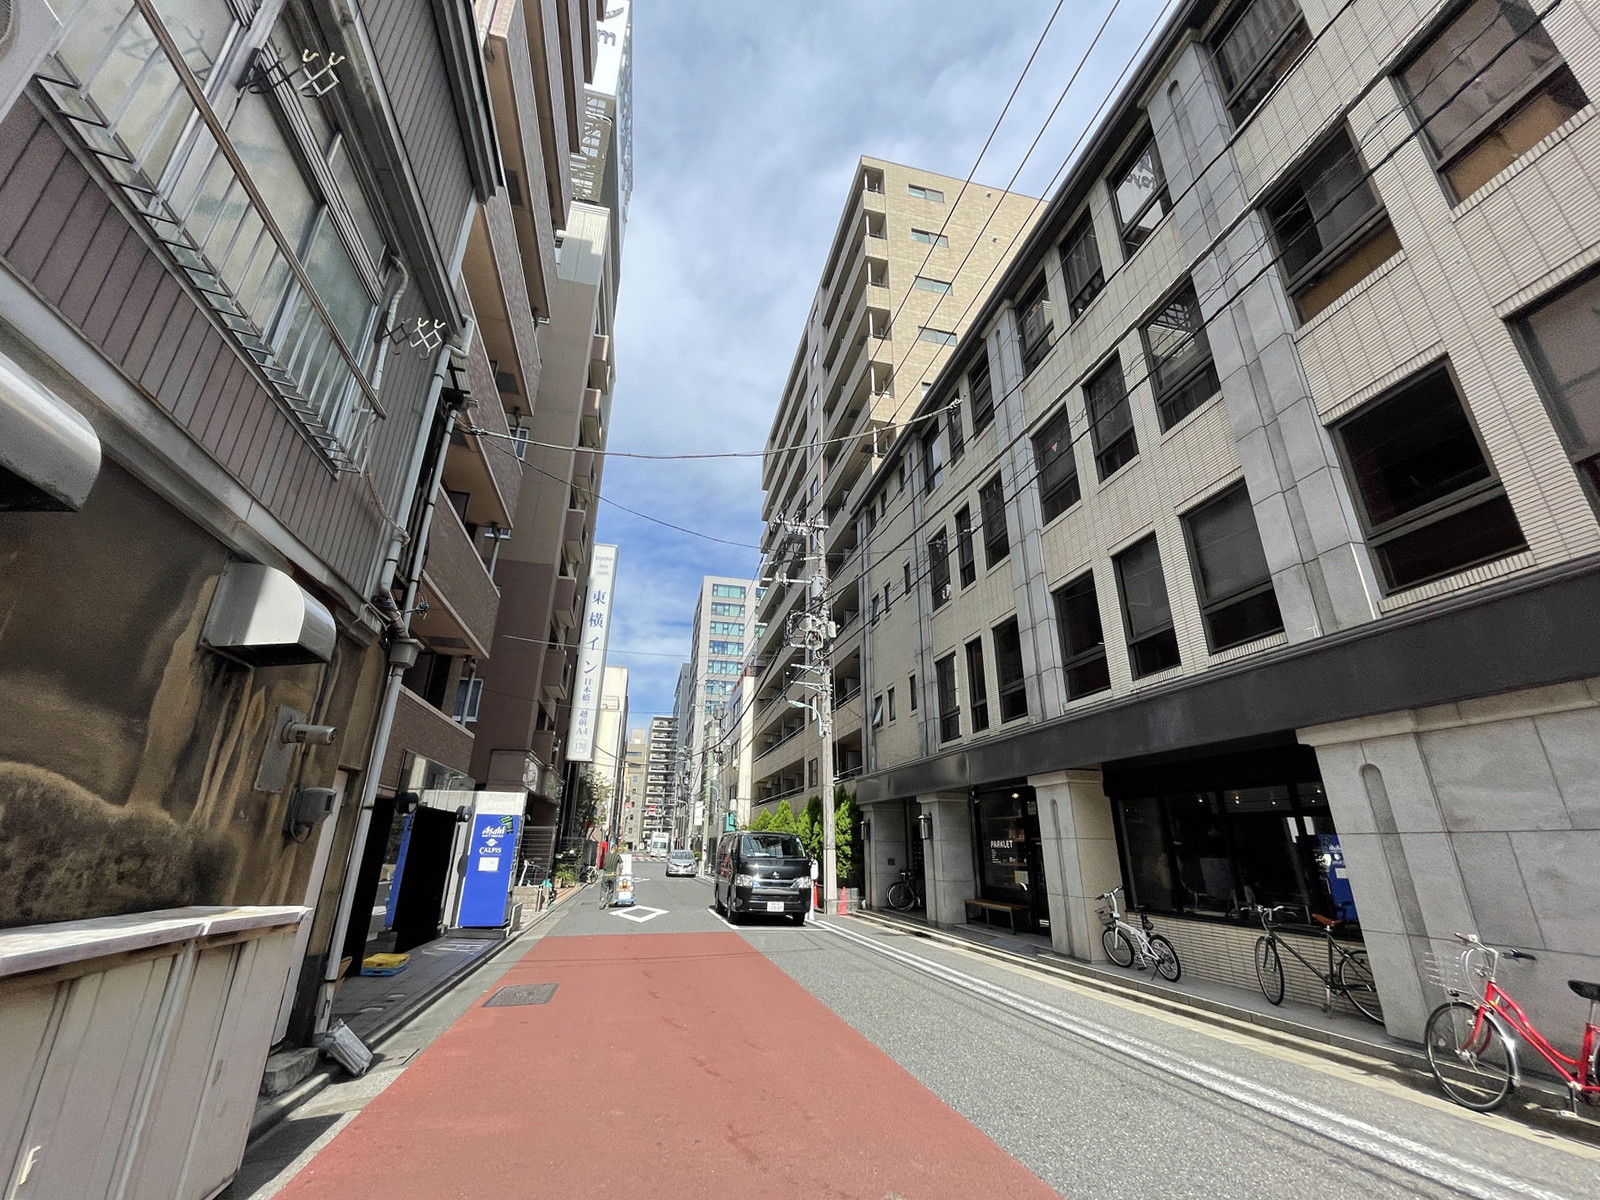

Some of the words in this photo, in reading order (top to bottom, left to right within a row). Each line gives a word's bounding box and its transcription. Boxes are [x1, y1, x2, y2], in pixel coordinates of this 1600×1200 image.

[584, 590, 606, 674] 東横イン
[482, 825, 506, 834] Asahi
[990, 840, 1013, 848] PARKLET
